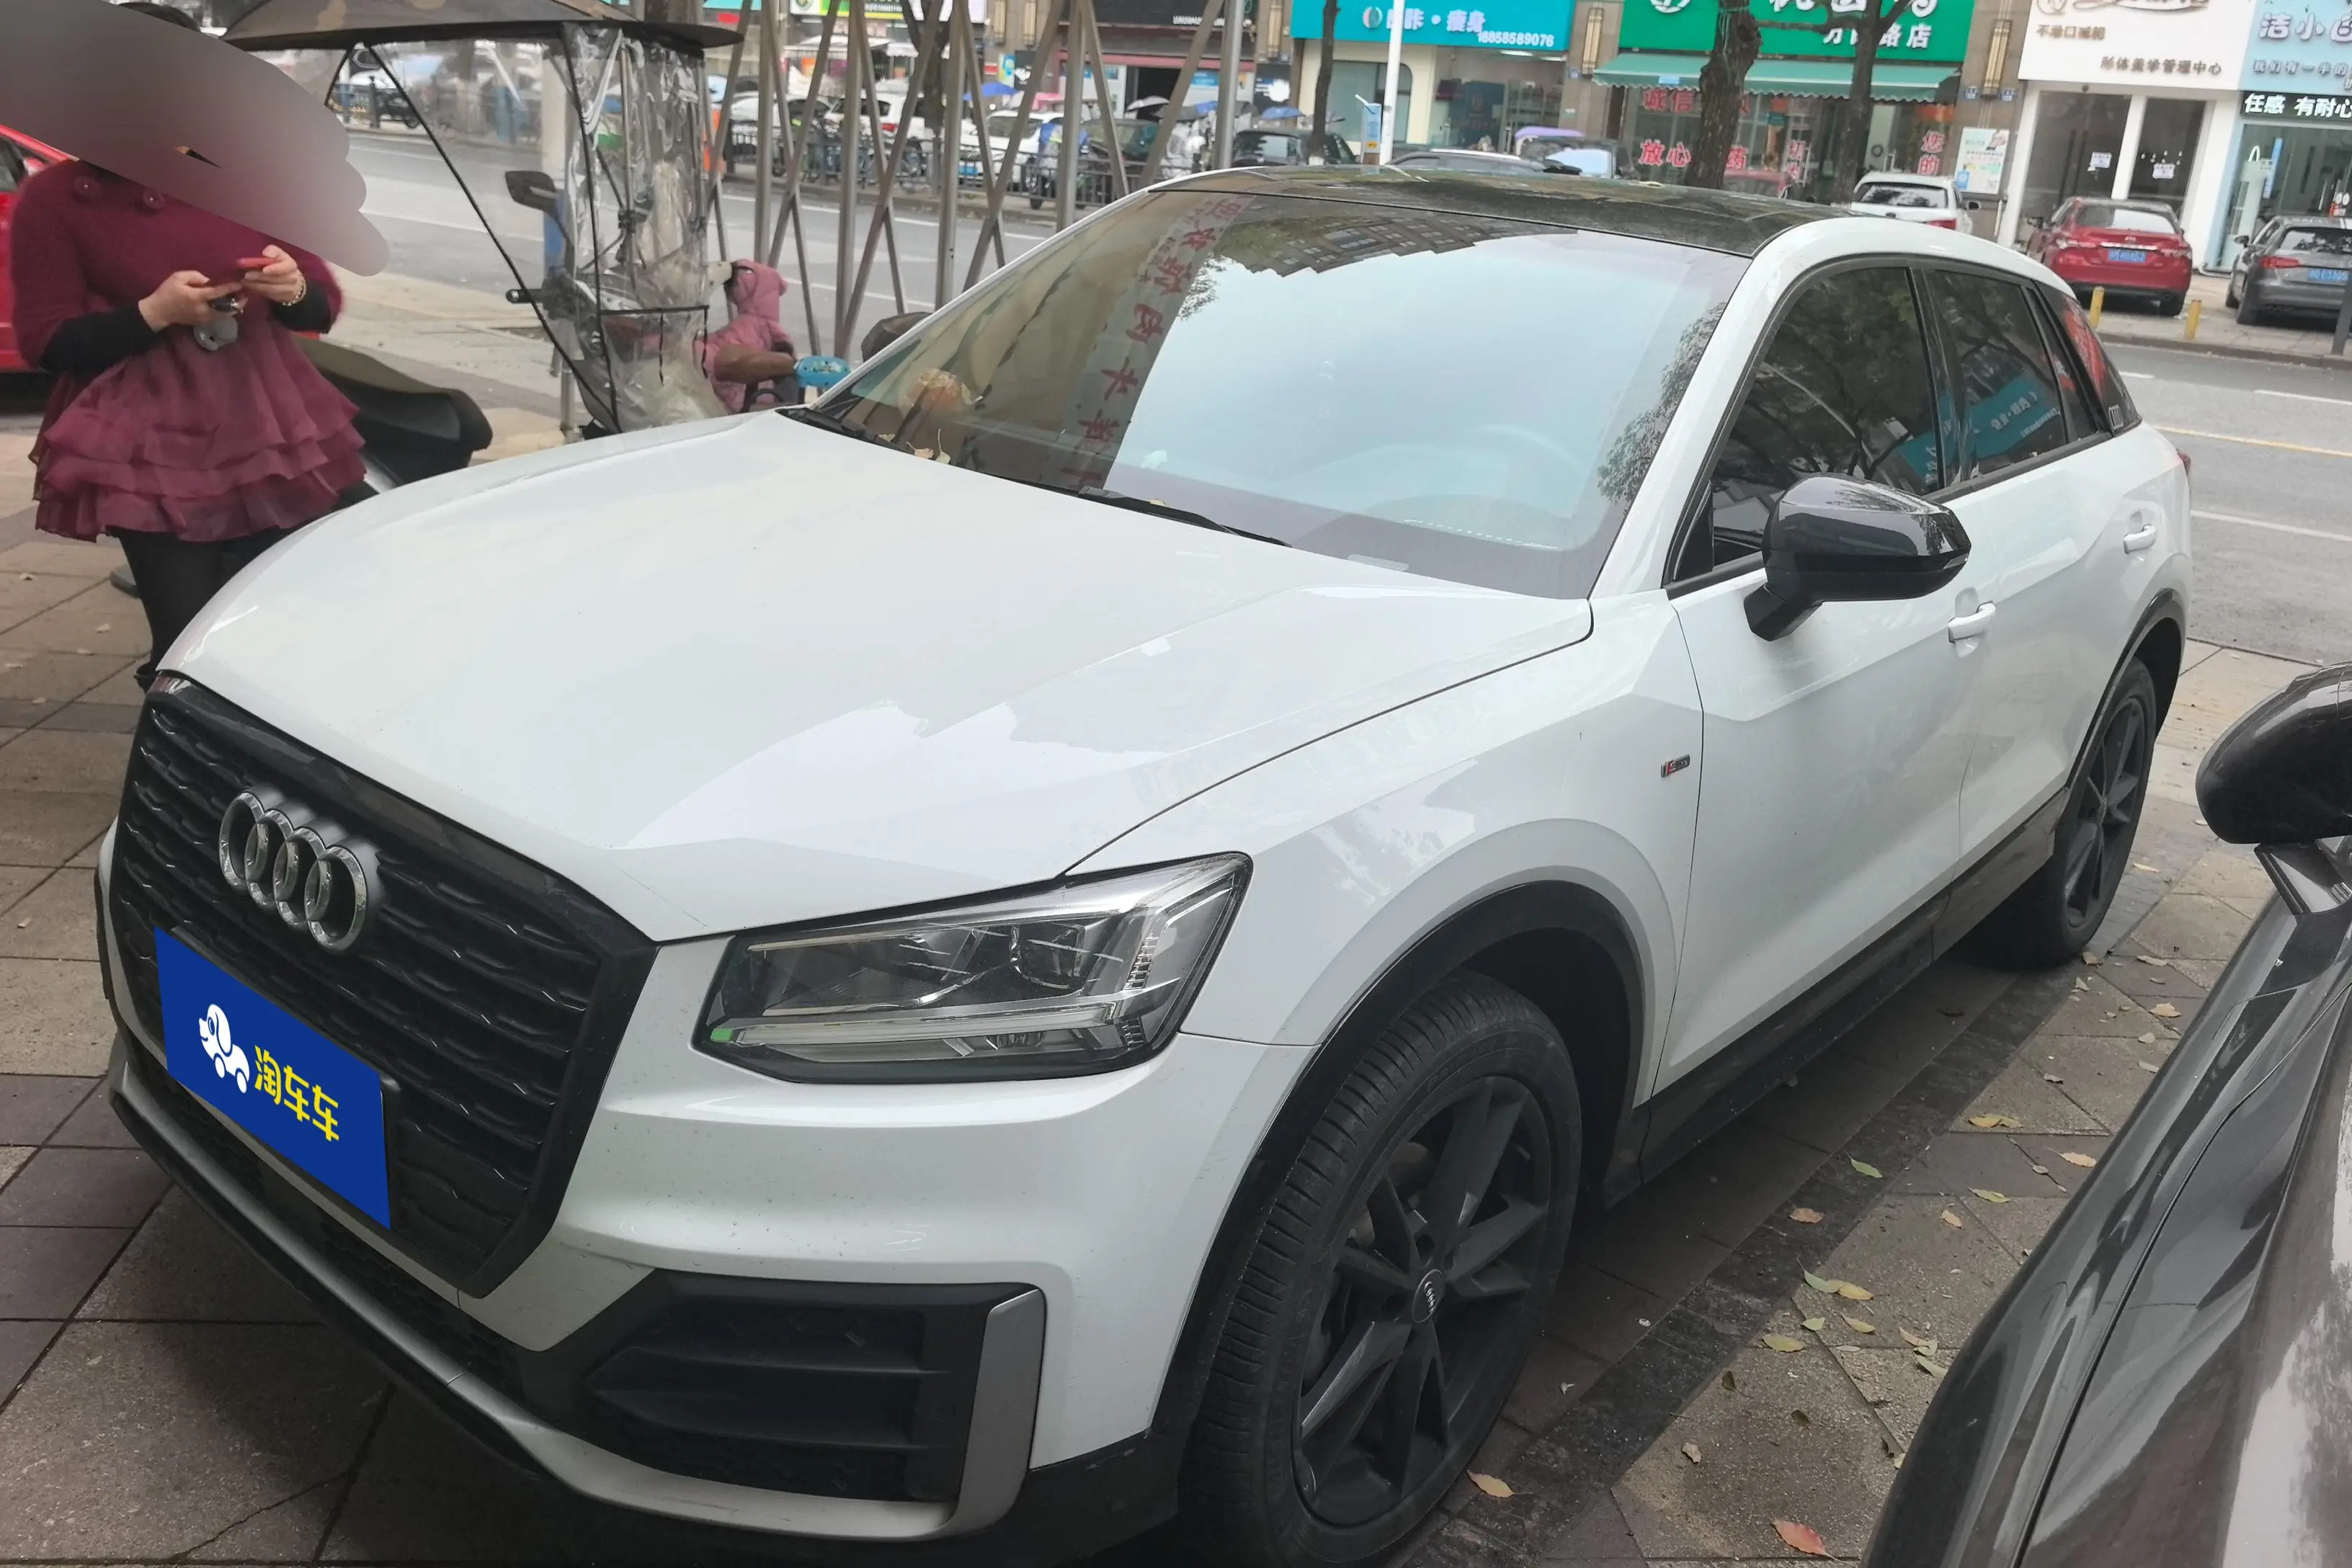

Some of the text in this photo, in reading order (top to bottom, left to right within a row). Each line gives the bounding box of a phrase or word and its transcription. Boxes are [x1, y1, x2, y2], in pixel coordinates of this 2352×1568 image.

[2245, 93, 2352, 119] 任感 有耐心
[1638, 138, 1752, 170] 放心药
